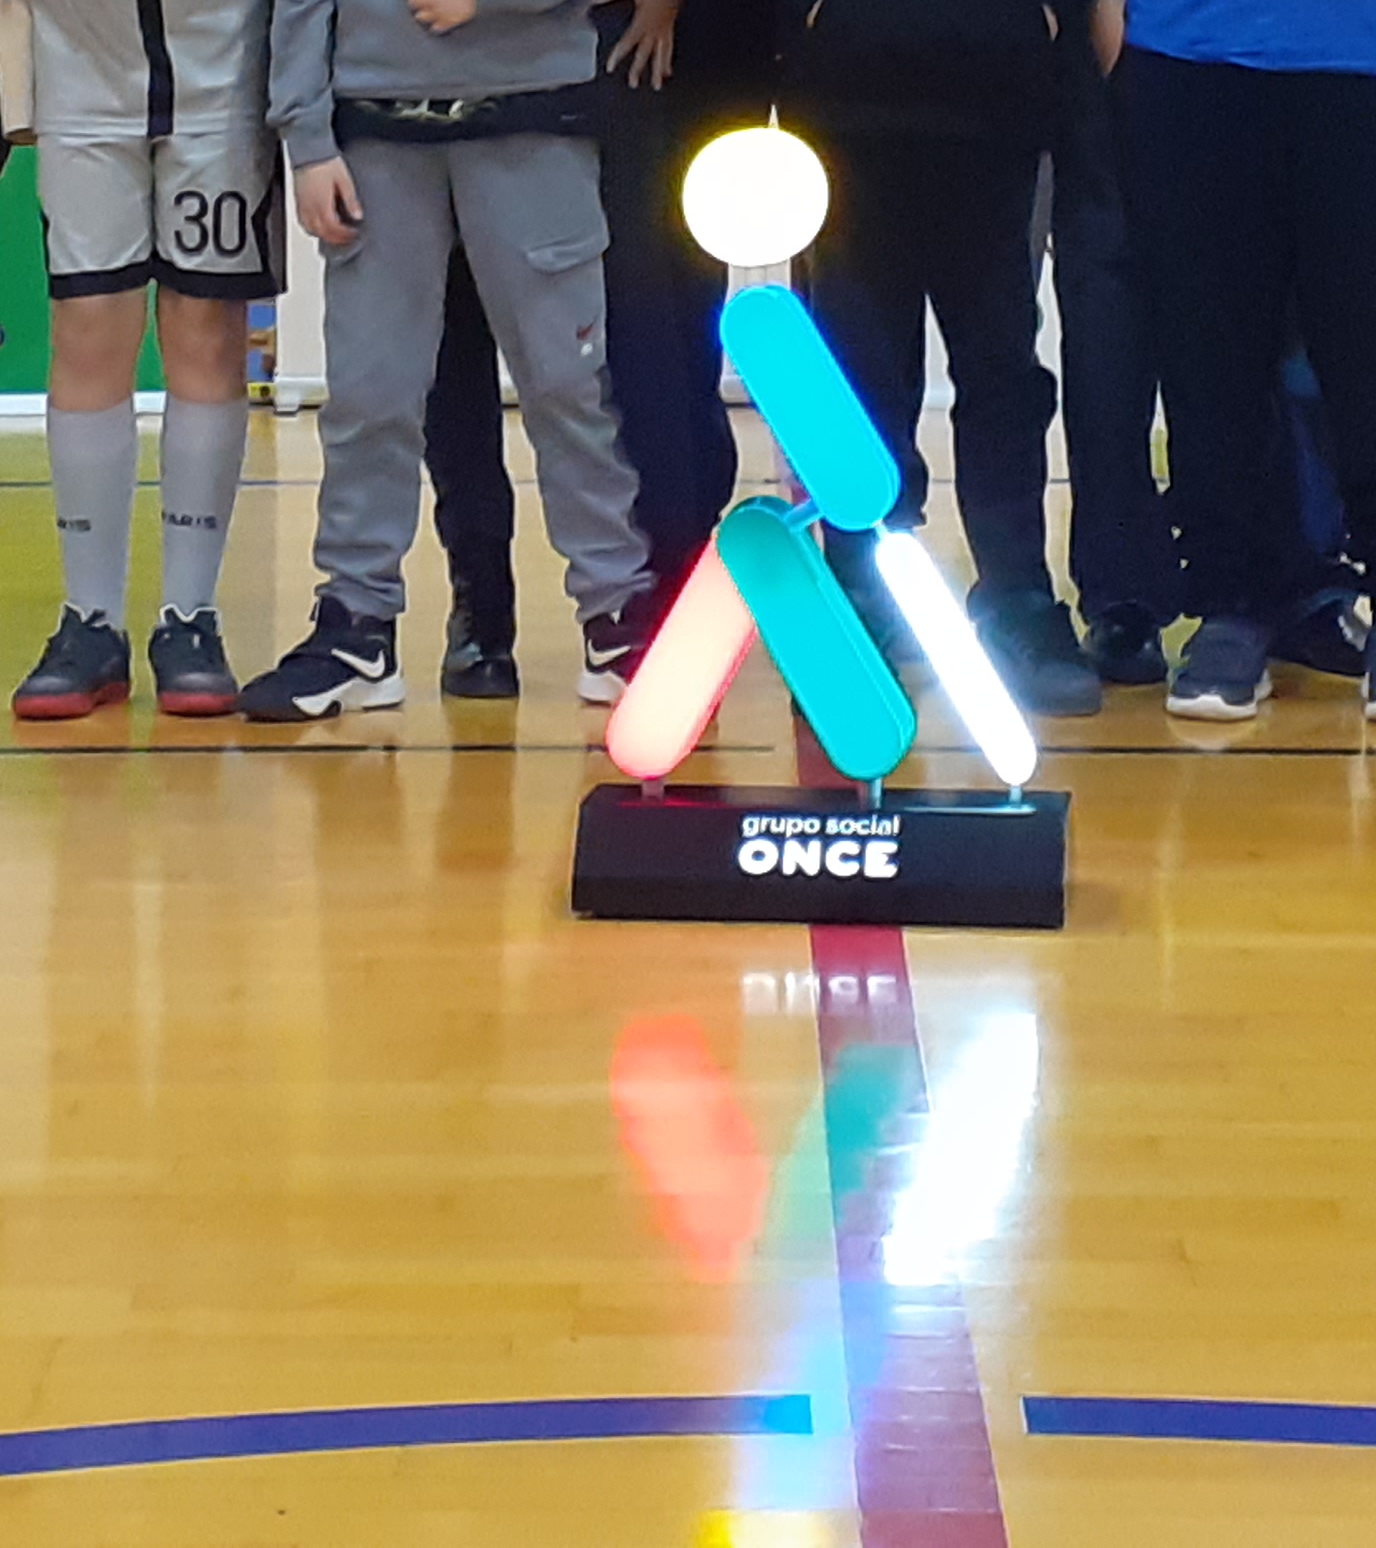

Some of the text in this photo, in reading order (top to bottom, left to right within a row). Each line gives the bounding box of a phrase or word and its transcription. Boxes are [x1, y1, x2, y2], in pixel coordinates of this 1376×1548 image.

[173, 190, 248, 260] 30
[741, 814, 901, 838] grupo social
[737, 838, 901, 879] ONCE
